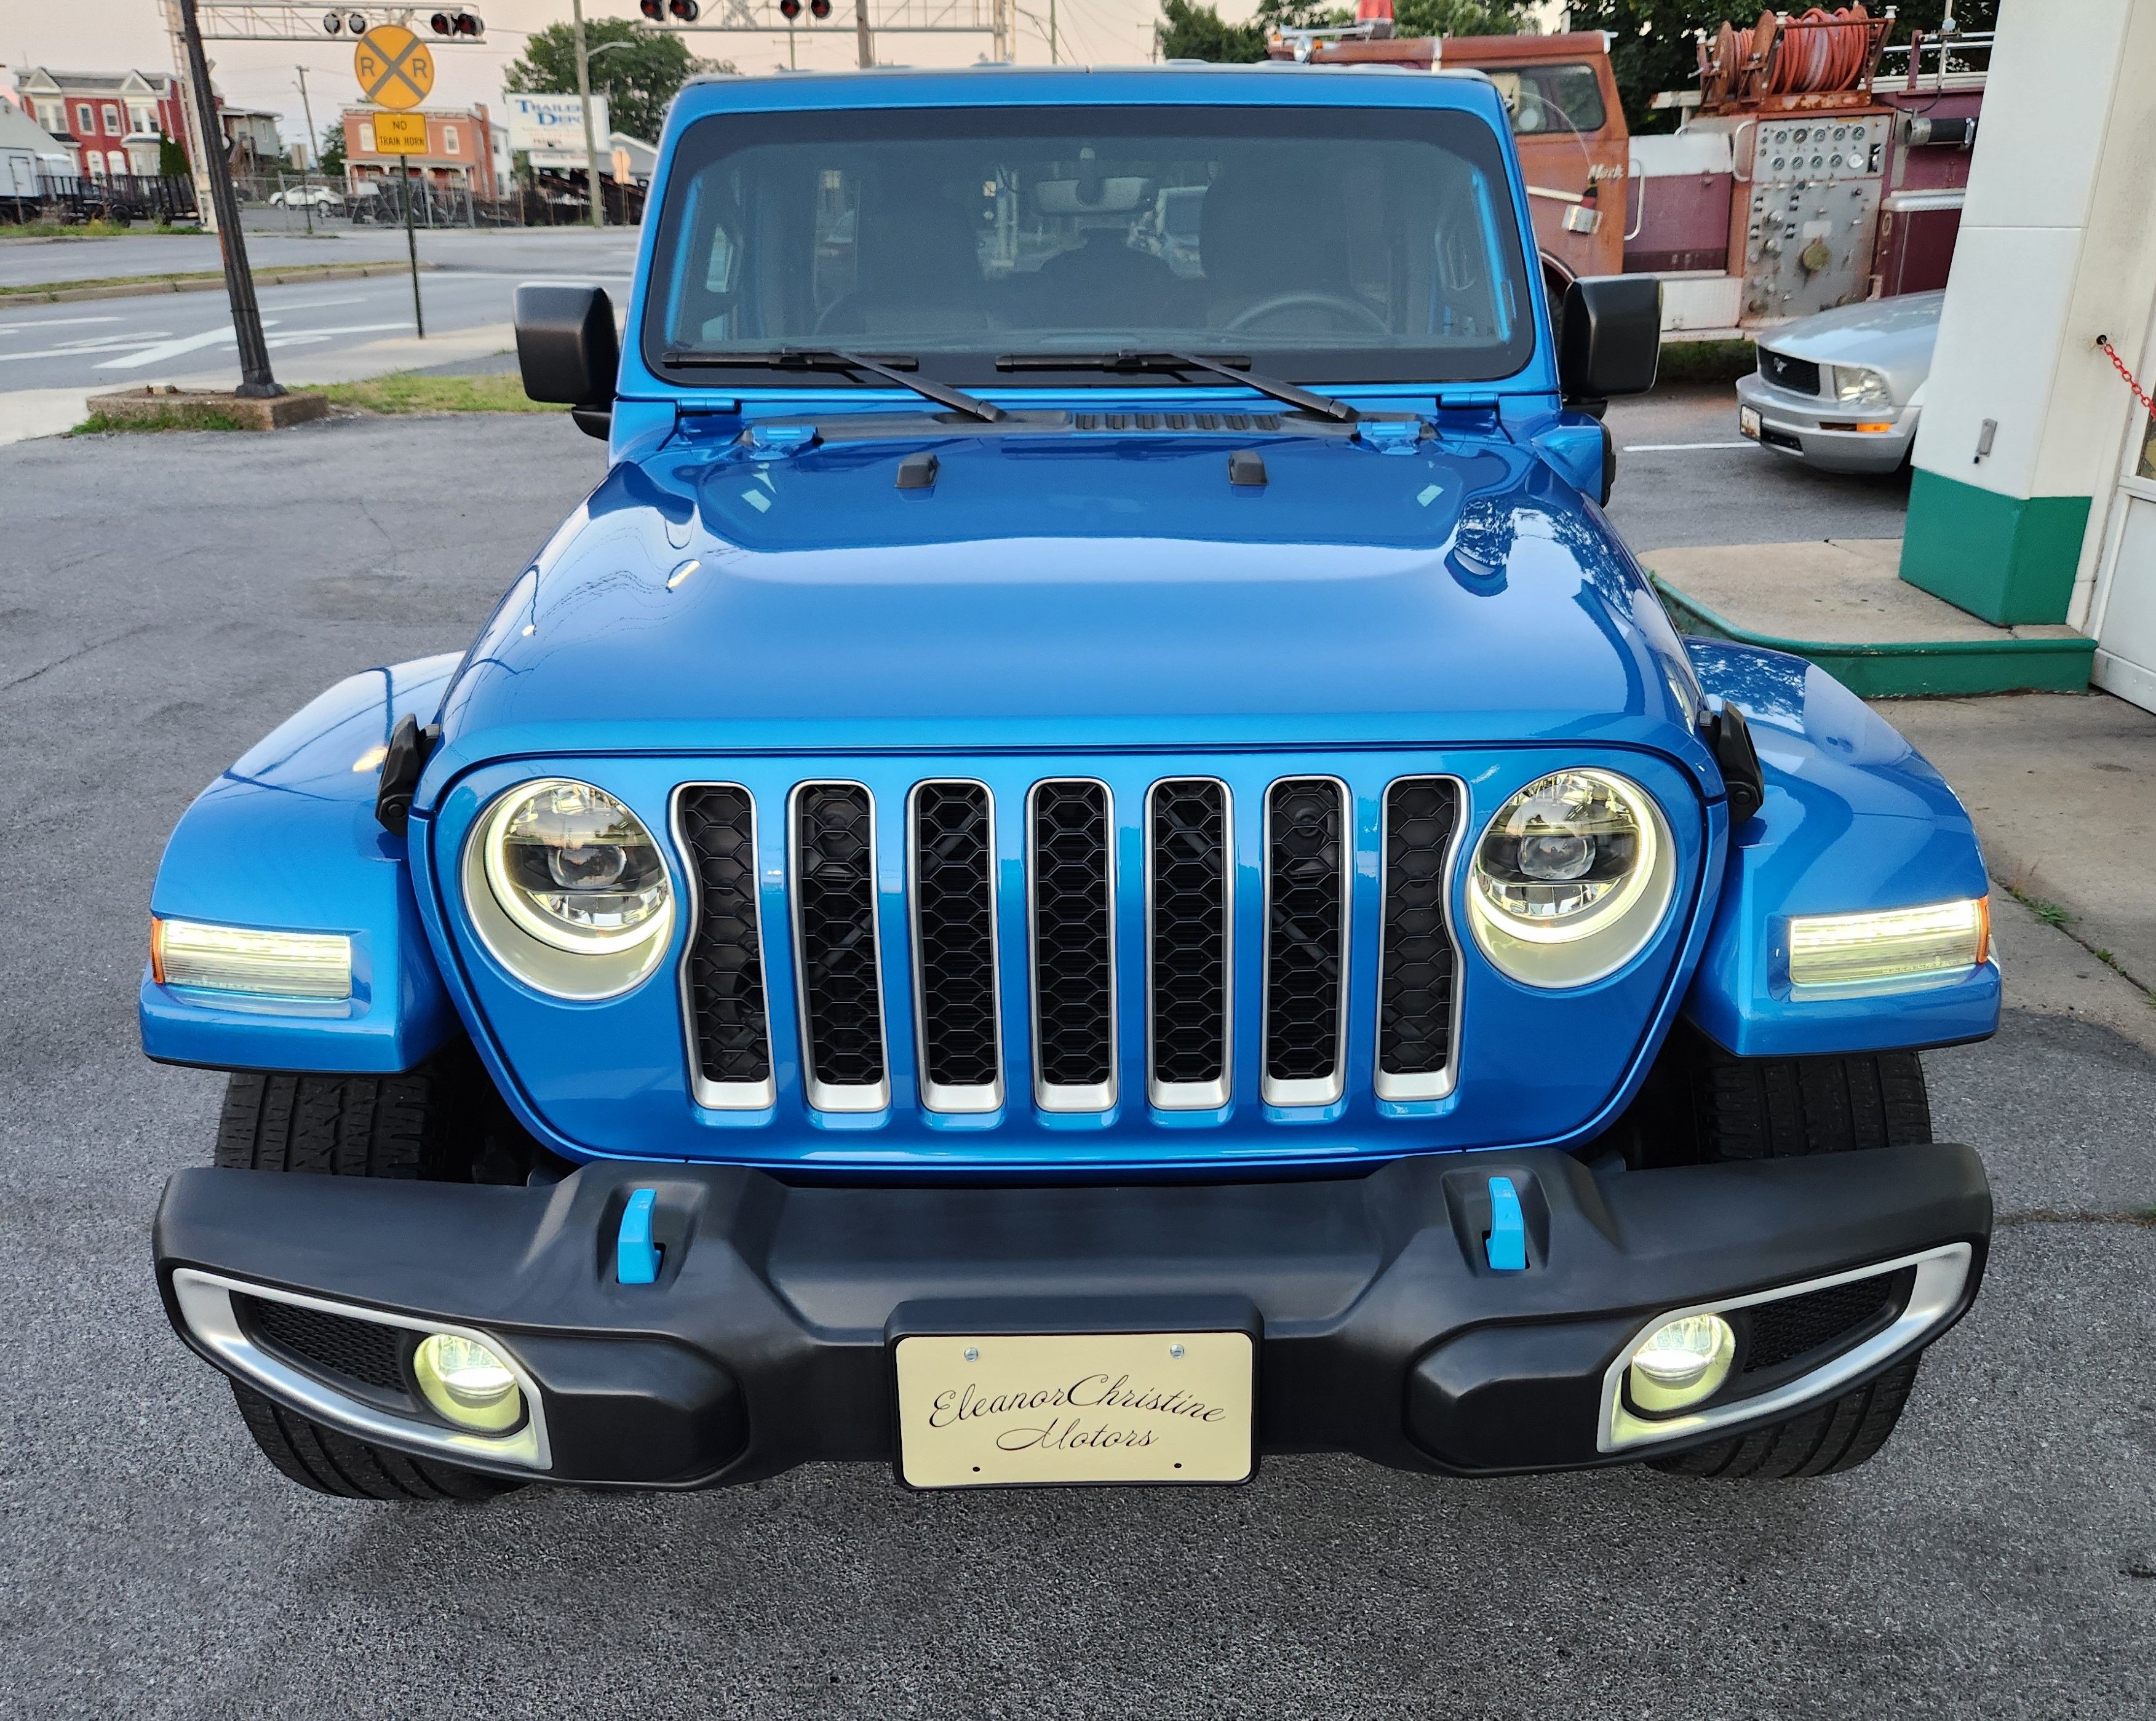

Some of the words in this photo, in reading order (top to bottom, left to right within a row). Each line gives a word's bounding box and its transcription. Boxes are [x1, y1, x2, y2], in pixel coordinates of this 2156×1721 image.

[360, 57, 375, 76] R
[413, 58, 428, 78] R
[538, 112, 586, 125] DEPO
[393, 121, 407, 130] NO
[379, 135, 400, 146] TRAIN
[404, 137, 424, 146] HORN
[996, 1417, 1160, 1451] Motors
